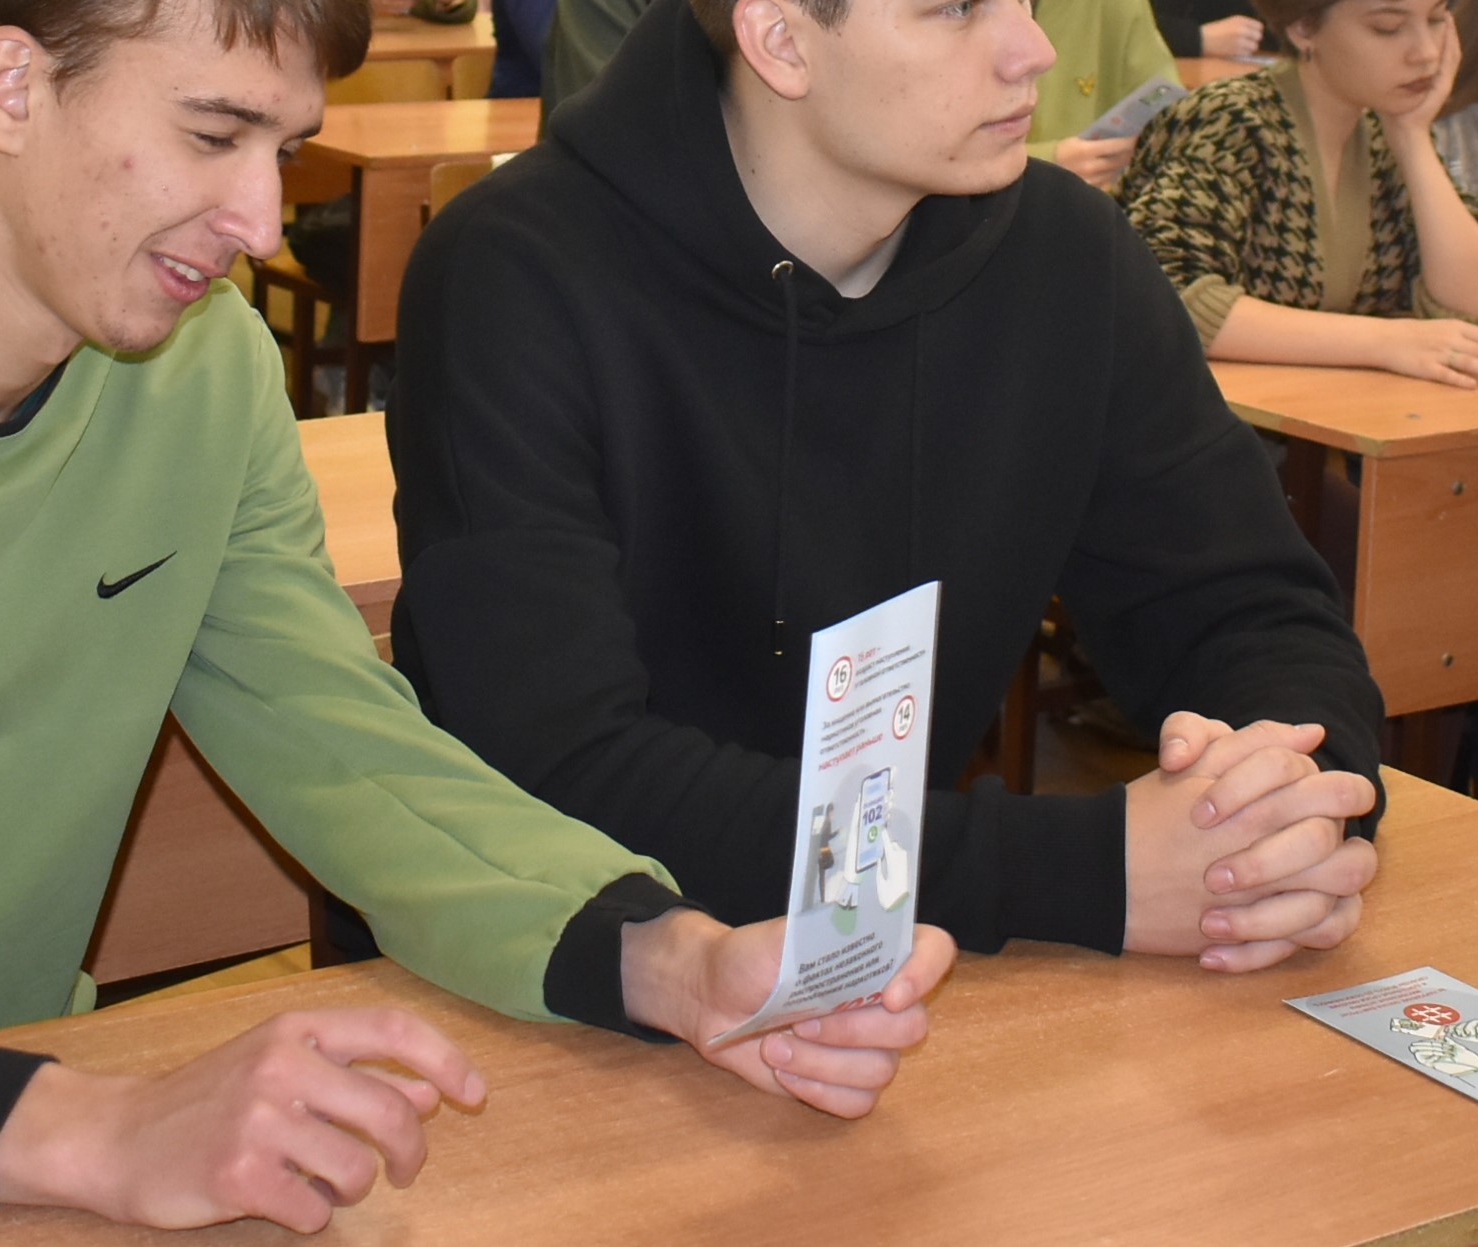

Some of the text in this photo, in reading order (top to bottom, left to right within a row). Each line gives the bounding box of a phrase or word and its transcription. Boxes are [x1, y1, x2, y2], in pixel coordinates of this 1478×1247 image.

[833, 664, 847, 686] 16
[899, 703, 910, 724] 14
[863, 804, 883, 826] 102
[799, 961, 817, 974] Вам
